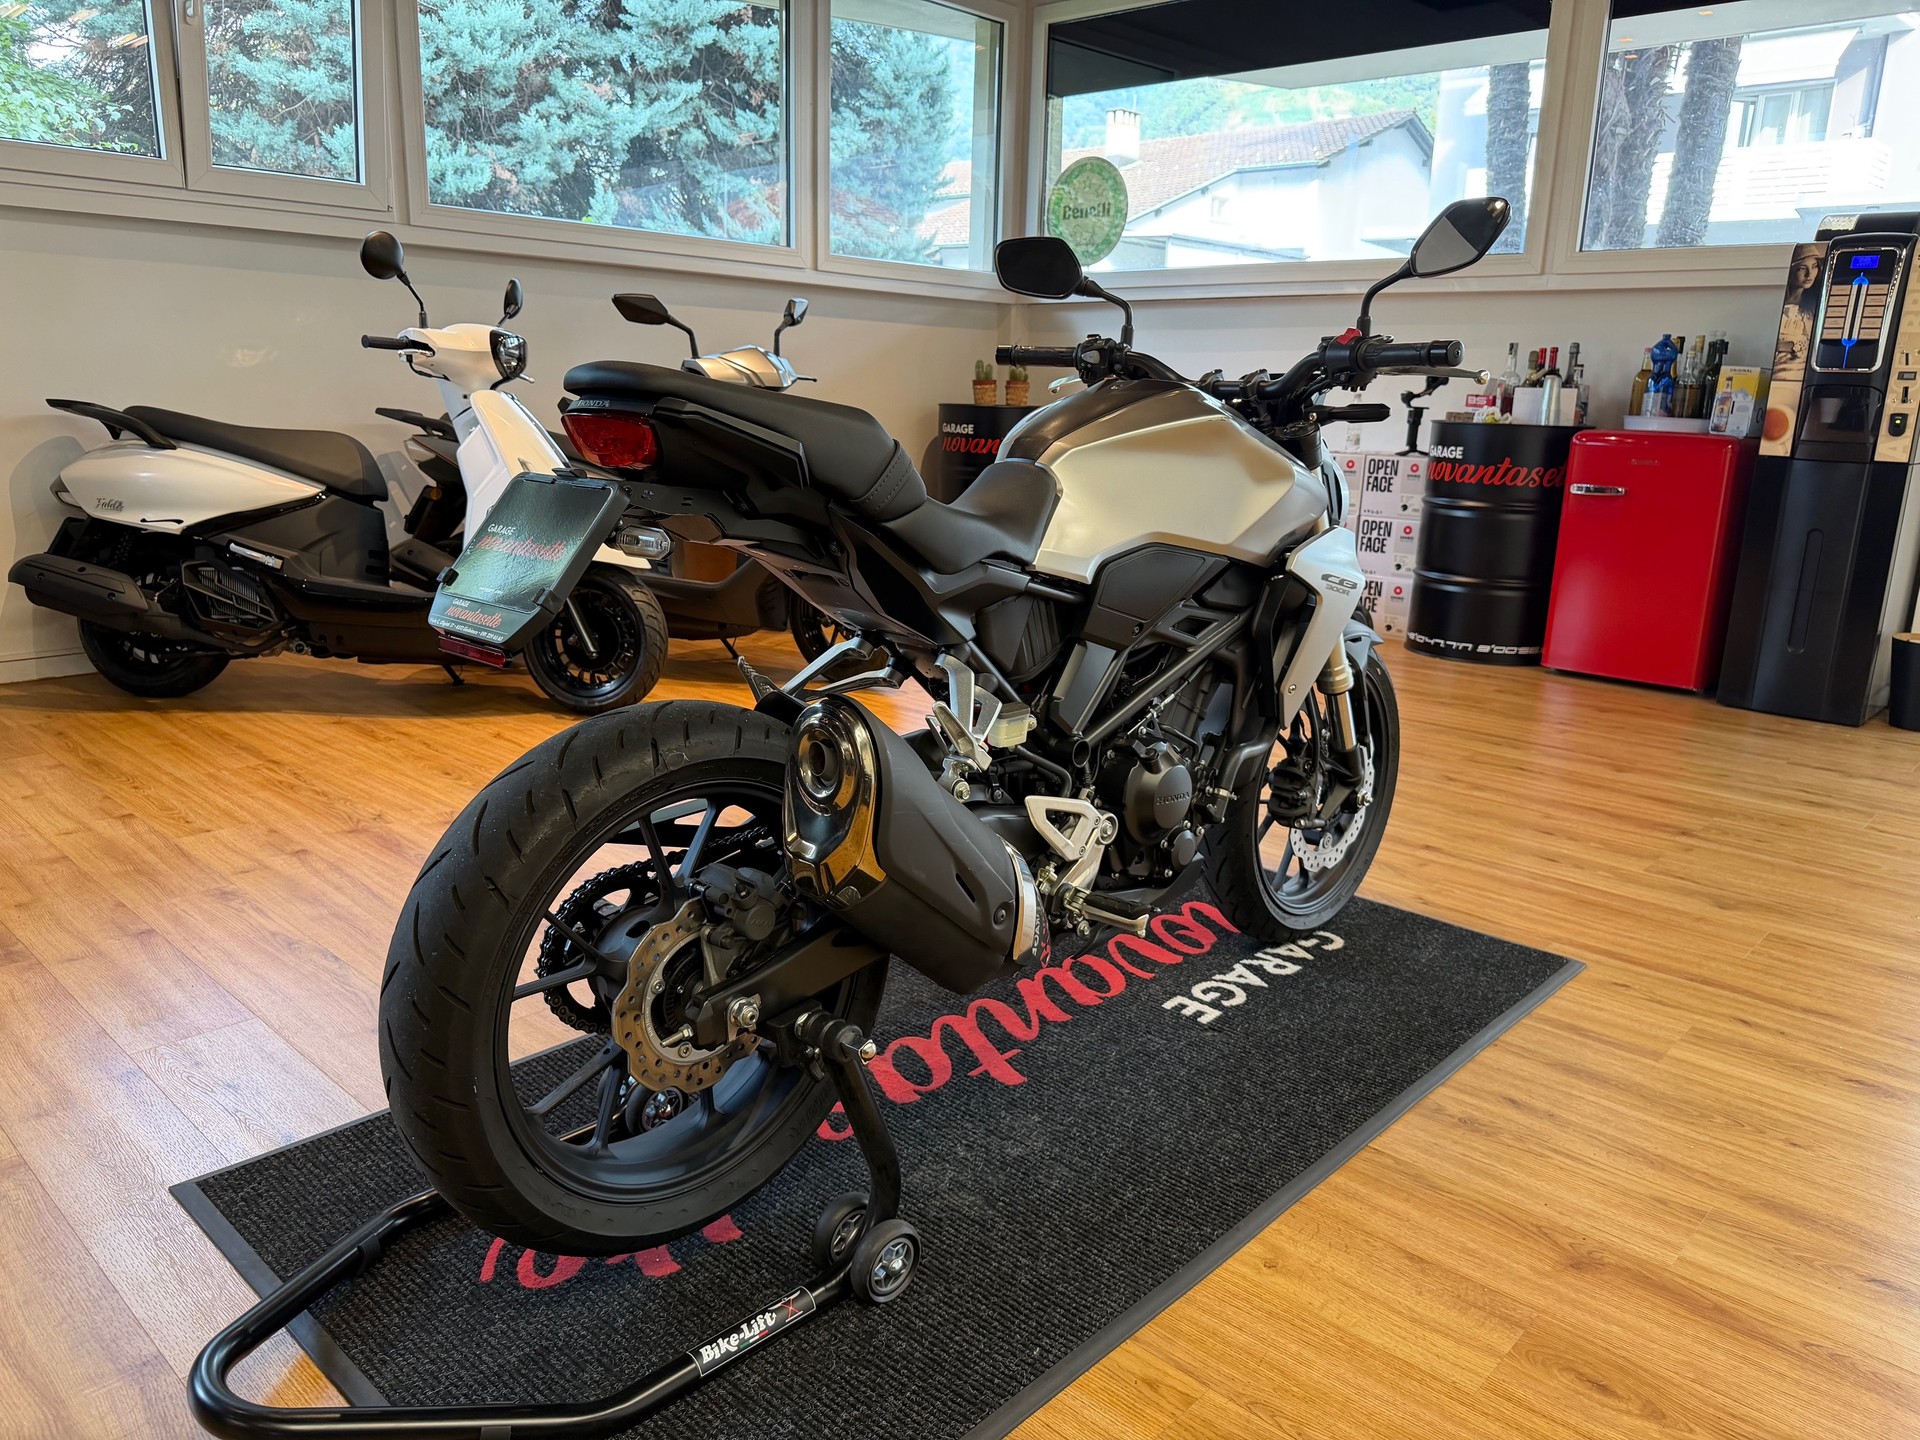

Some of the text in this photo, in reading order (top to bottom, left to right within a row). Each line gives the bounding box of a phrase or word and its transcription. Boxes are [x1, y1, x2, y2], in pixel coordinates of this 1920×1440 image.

[577, 400, 610, 408] HONDA
[942, 422, 975, 435] GARAGE
[943, 436, 1001, 455] novan
[1430, 445, 1464, 459] GARAGE
[1368, 459, 1399, 476] OPEN
[1427, 457, 1568, 488] novantaset
[1366, 476, 1394, 493] FACE
[488, 523, 516, 535] GARAGE
[1362, 519, 1392, 537] OPEN
[1360, 536, 1387, 553] FACE
[1321, 573, 1358, 590] CB
[1325, 583, 1350, 597] 300R
[452, 598, 471, 608] GARAGE
[444, 606, 502, 628] novantasette
[1156, 791, 1190, 805] HONDA
[1162, 931, 1345, 1024] GARAGE
[699, 1312, 777, 1364] Bike-Lift
